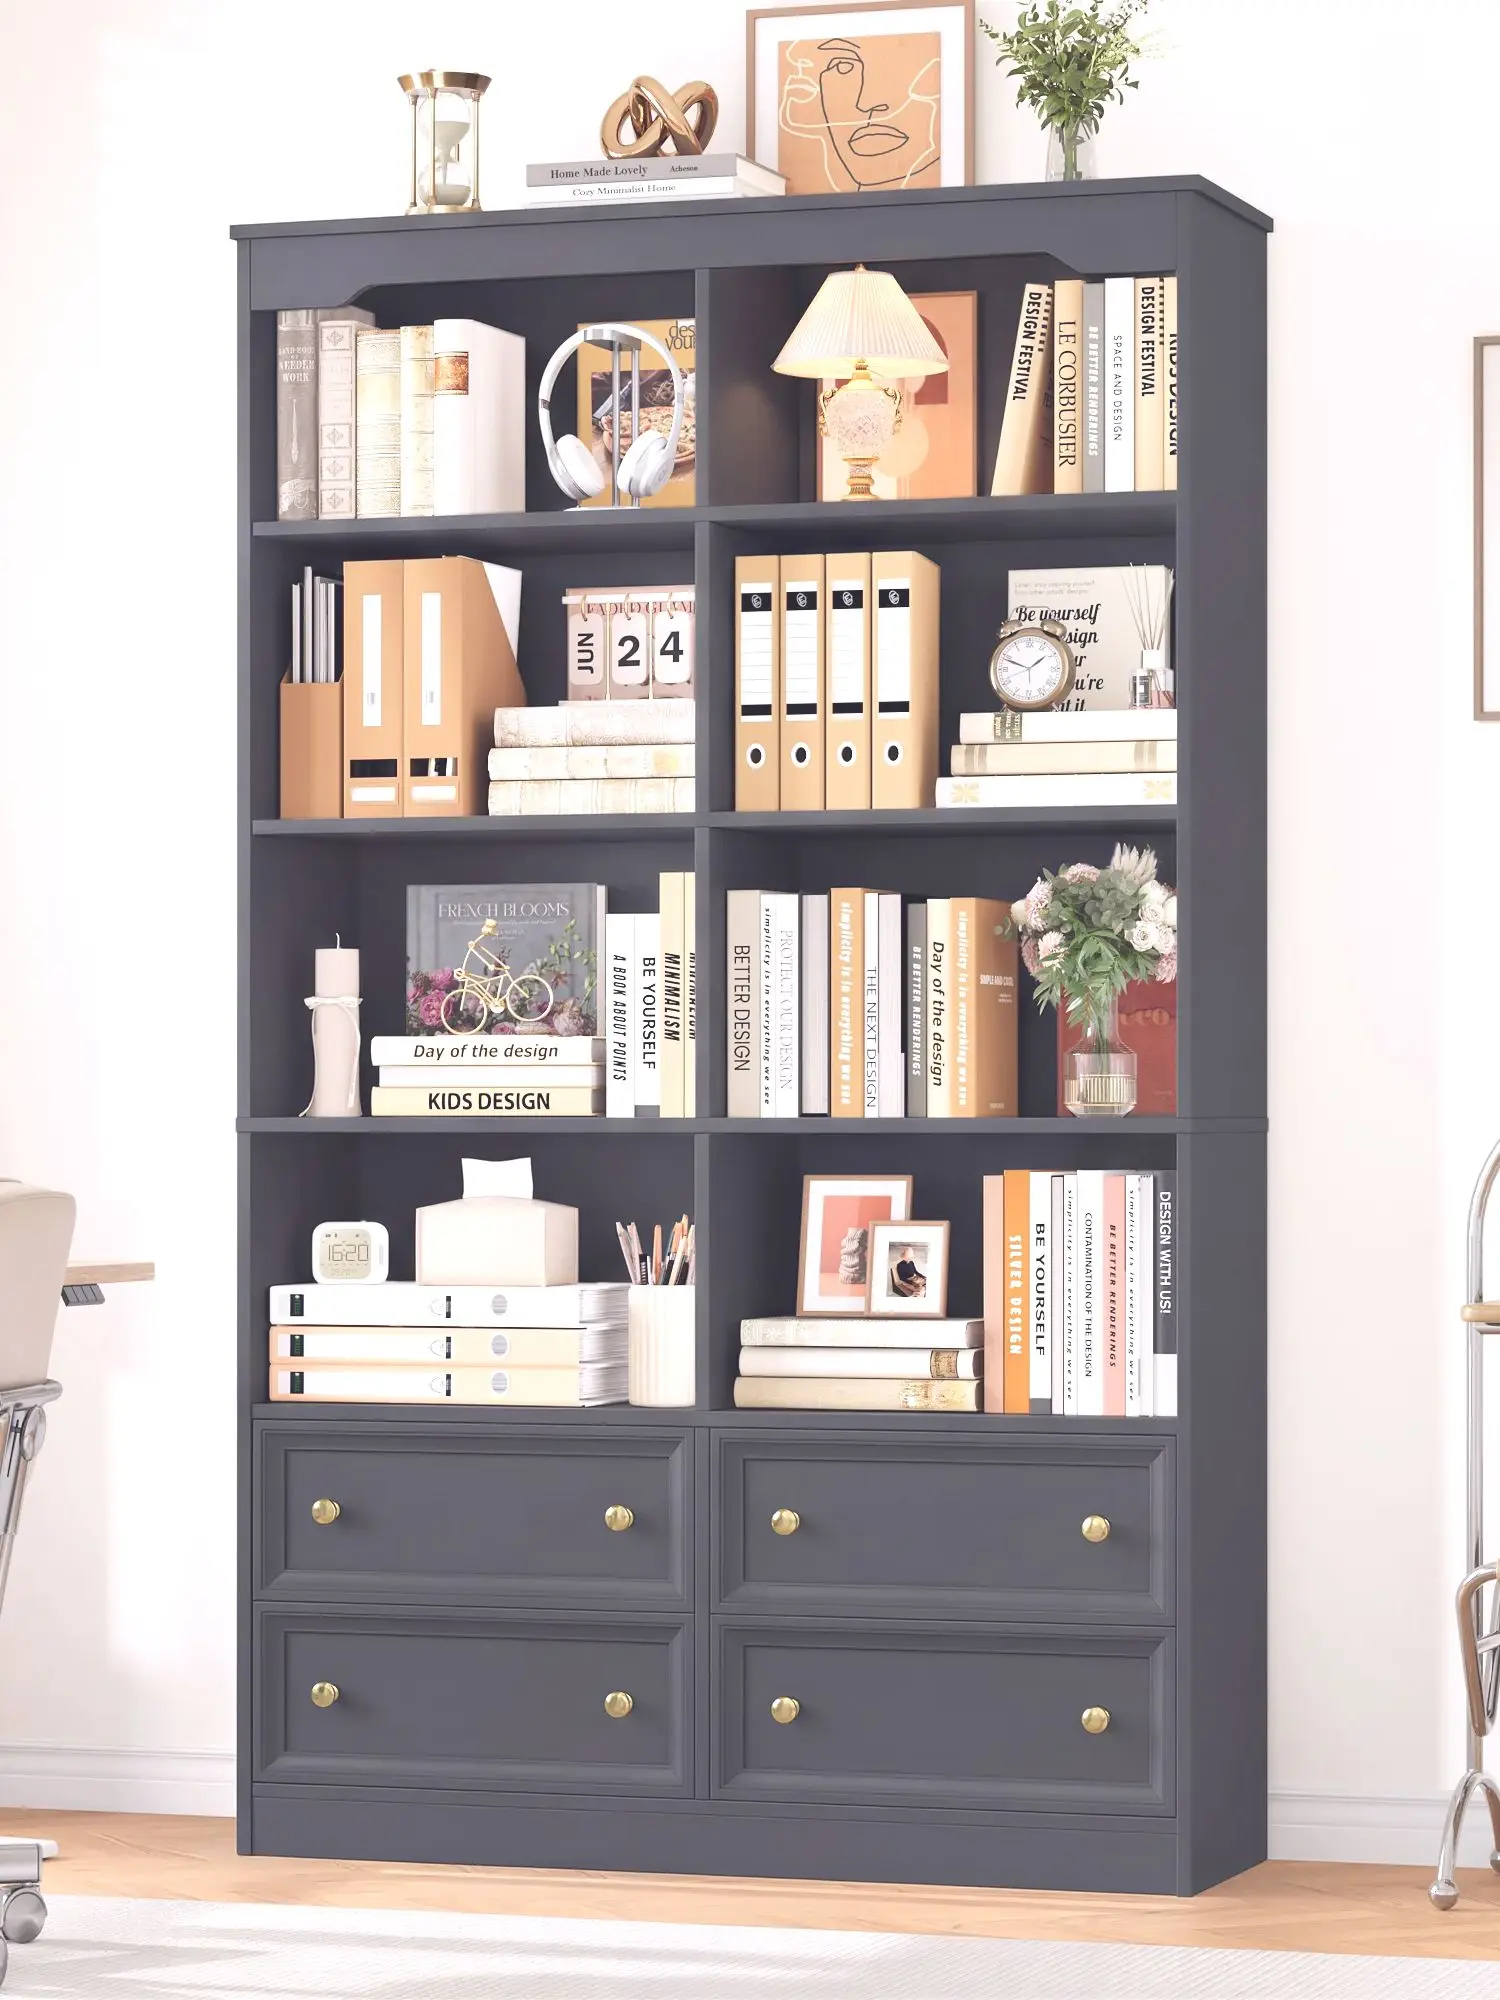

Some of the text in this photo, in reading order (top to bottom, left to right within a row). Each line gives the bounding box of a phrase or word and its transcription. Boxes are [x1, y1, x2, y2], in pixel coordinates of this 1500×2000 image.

[550, 165, 648, 179] Home Made Lovely
[572, 184, 676, 197] Cozy Minimalist Home
[1012, 292, 1042, 401] DESIGN FESTIVAL
[1141, 286, 1155, 397] DESIGN FESTIVAL
[1058, 320, 1076, 468] LE CORBUSIER
[1113, 335, 1122, 441] SPACE AND DESIGN
[1015, 606, 1036, 622] Be
[577, 633, 594, 674] JUN
[617, 631, 684, 667] 2 4
[1065, 628, 1099, 649] sign
[438, 902, 570, 918] FRENCH BLOOMS
[838, 901, 854, 963] simplicity
[956, 911, 969, 970] simplicity
[613, 965, 626, 996] BOOK
[763, 970, 770, 979] is
[763, 984, 770, 995] in
[840, 966, 853, 977] is
[643, 957, 656, 1069] BE YOURSELF
[664, 952, 681, 1042] MINIMALISM
[734, 945, 751, 1072] BETTER DESIGN
[780, 930, 793, 1090] PROTECT OUR DESIGN
[912, 946, 922, 1077] BE BETTER RENDERINGS
[930, 941, 945, 1087] Day of the design
[613, 1001, 626, 1037] ABOUT
[838, 996, 854, 1061] everything
[866, 966, 877, 1108] THE NEXT DESIGN
[414, 1044, 559, 1061] Day of the design
[613, 1041, 626, 1081] POINTS
[763, 1066, 770, 1081] we
[428, 1092, 550, 1110] KIDS DESIGN
[1110, 1225, 1116, 1238] BE
[1159, 1191, 1171, 1314] DESIGN WITH US!
[1009, 1234, 1022, 1355] SILVER DESIGN
[1036, 1223, 1045, 1356] BE YOURSELF
[1085, 1301, 1092, 1316] OF
